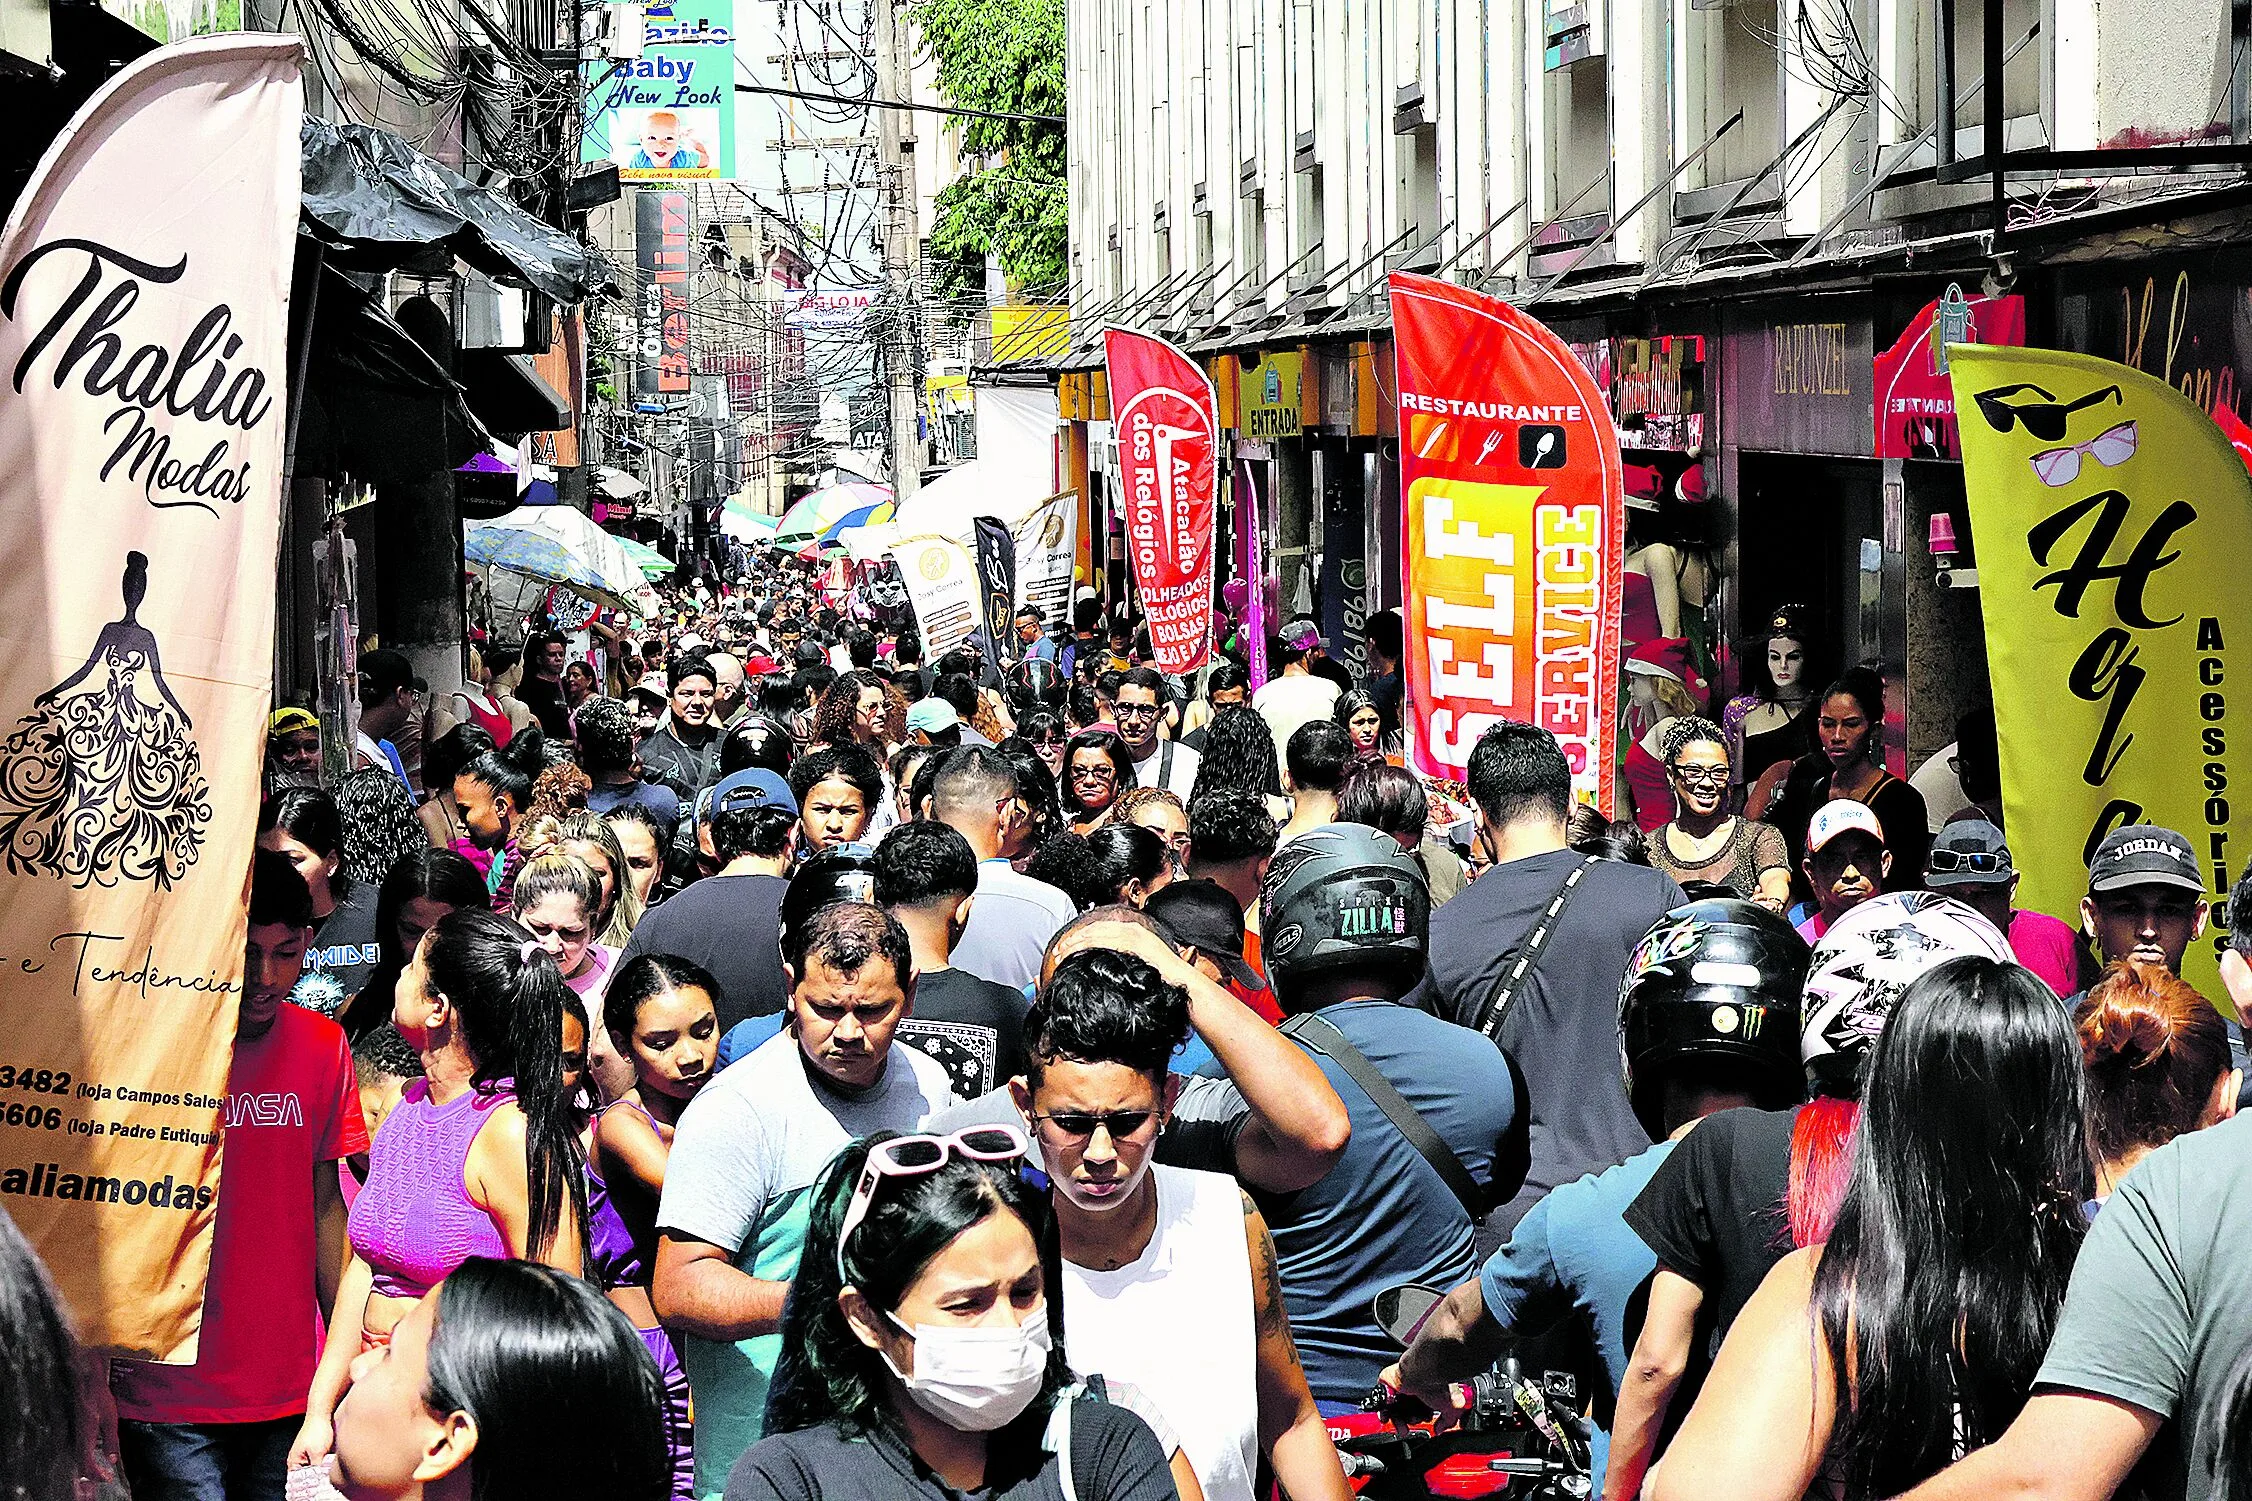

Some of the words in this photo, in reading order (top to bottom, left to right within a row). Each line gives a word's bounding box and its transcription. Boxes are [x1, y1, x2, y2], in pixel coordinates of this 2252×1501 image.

[606, 86, 661, 108] New
[664, 86, 721, 108] Look
[648, 171, 673, 179] novo
[677, 166, 712, 179] visual
[654, 194, 689, 393] Berlim
[1774, 324, 1851, 396] RAPUNZEL
[1251, 409, 1299, 436] ENTRADA
[1401, 391, 1582, 422] RESTAURANTE
[1132, 412, 1153, 469] dos
[99, 405, 251, 519] Modas
[1134, 467, 1158, 579] Relógios
[1171, 456, 1197, 575] Atacadão
[1155, 615, 1206, 643] BOLSAS
[1422, 494, 1516, 768] SELF
[2113, 837, 2183, 863] JORDAN
[1340, 907, 1394, 936] ZILLA
[50, 930, 243, 1000] Tendência
[0, 1065, 72, 1095] 3482
[76, 1082, 111, 1101] (loja
[116, 1086, 180, 1107] Campos
[67, 1118, 105, 1136] (loja
[109, 1122, 156, 1140] Padre
